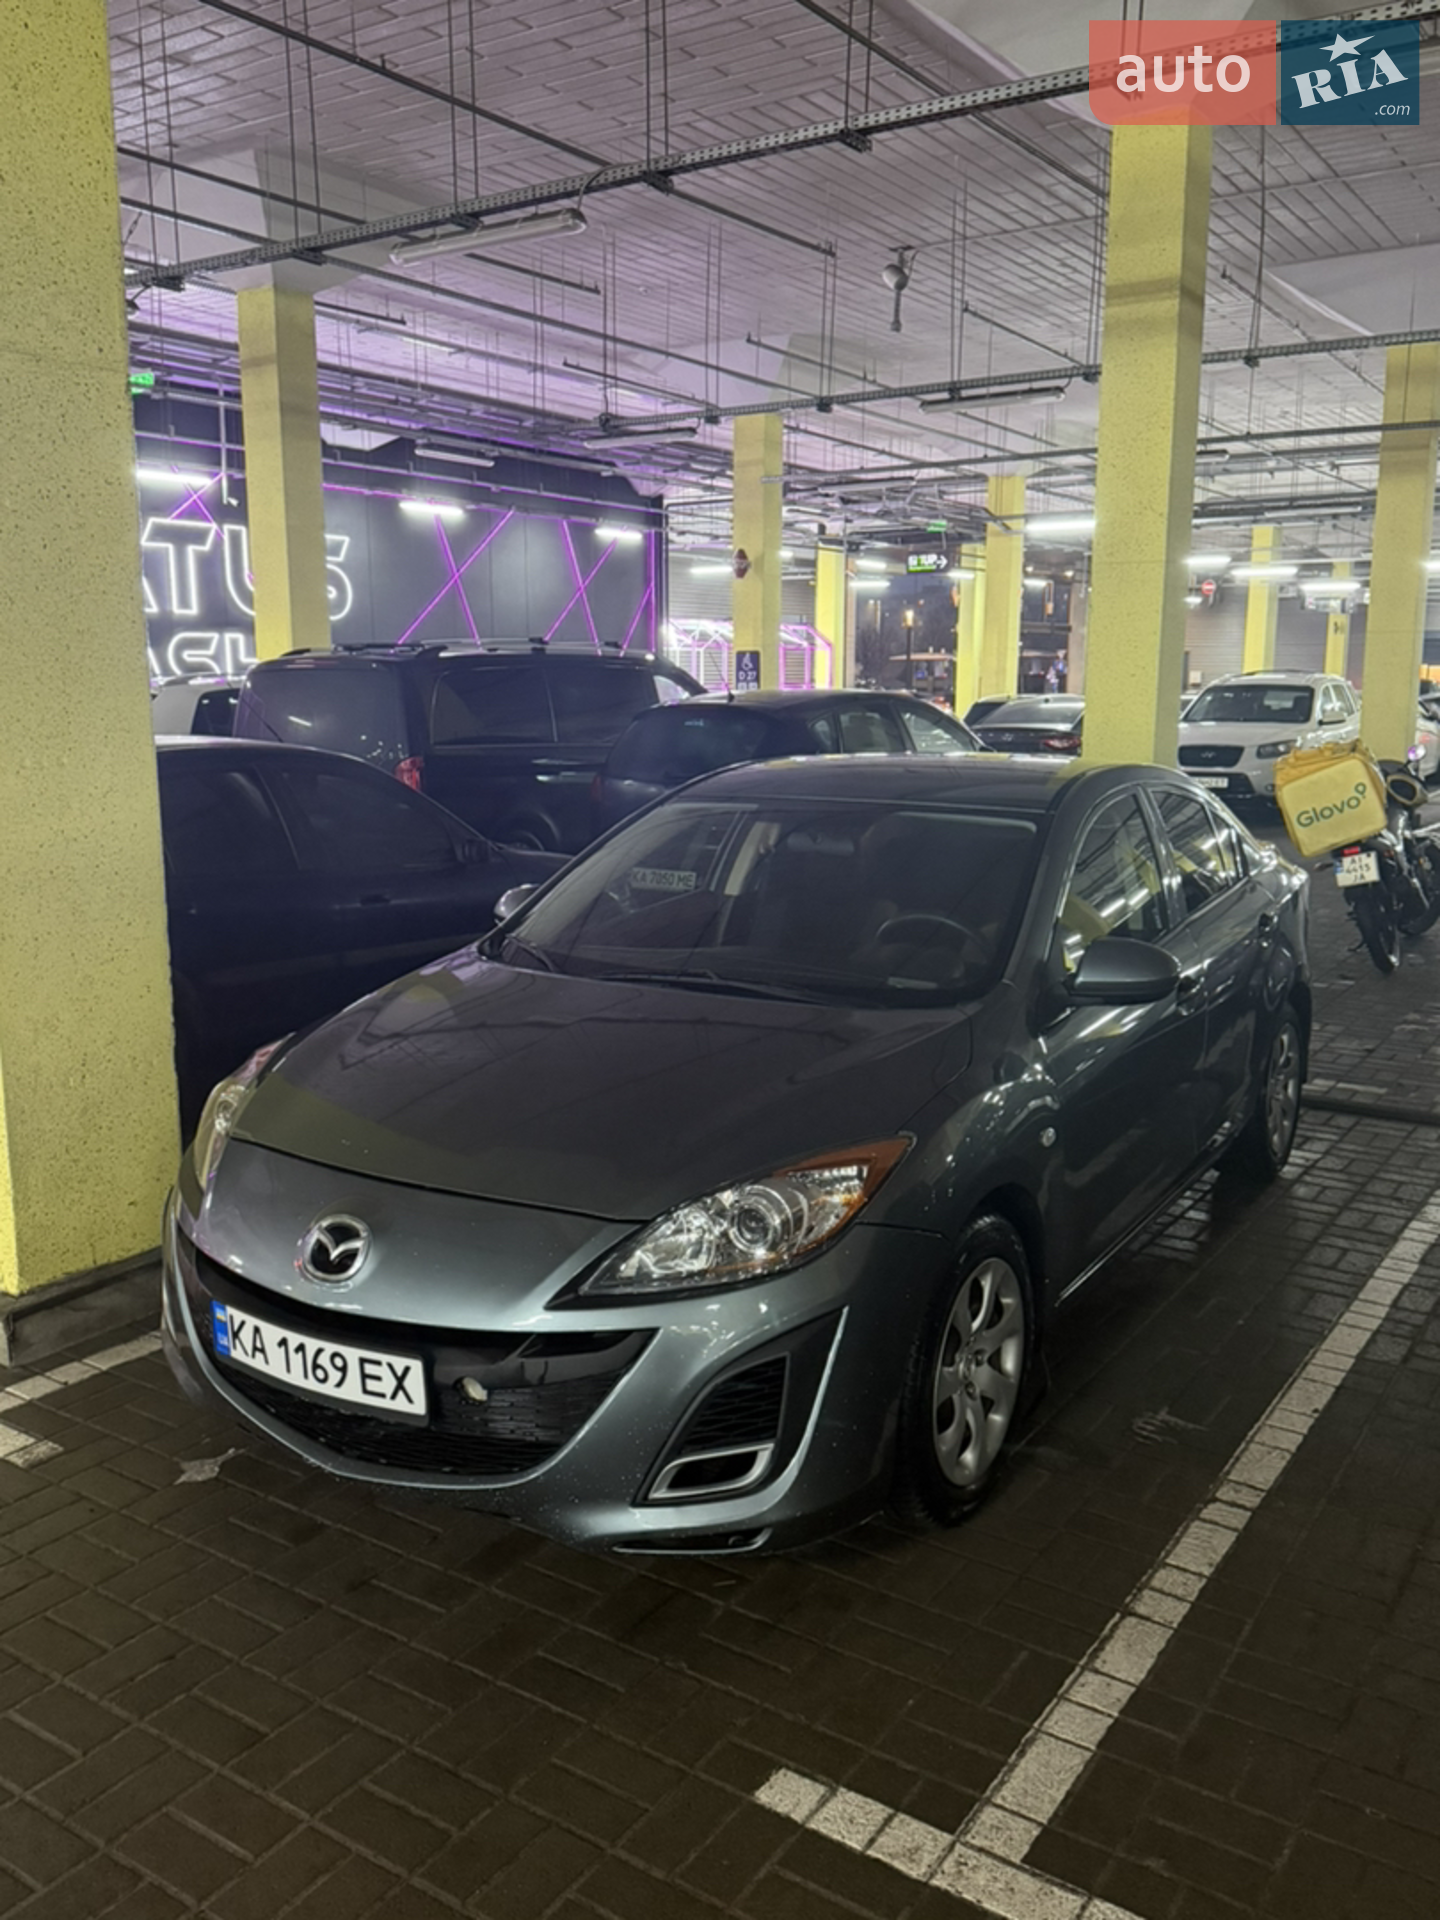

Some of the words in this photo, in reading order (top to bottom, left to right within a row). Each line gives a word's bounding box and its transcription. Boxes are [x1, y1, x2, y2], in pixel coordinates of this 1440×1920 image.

[1296, 794, 1361, 828] Glovo
[632, 869, 647, 883] KA
[229, 1313, 270, 1366] KA
[277, 1336, 348, 1389] 1169
[358, 1356, 415, 1405] EX
